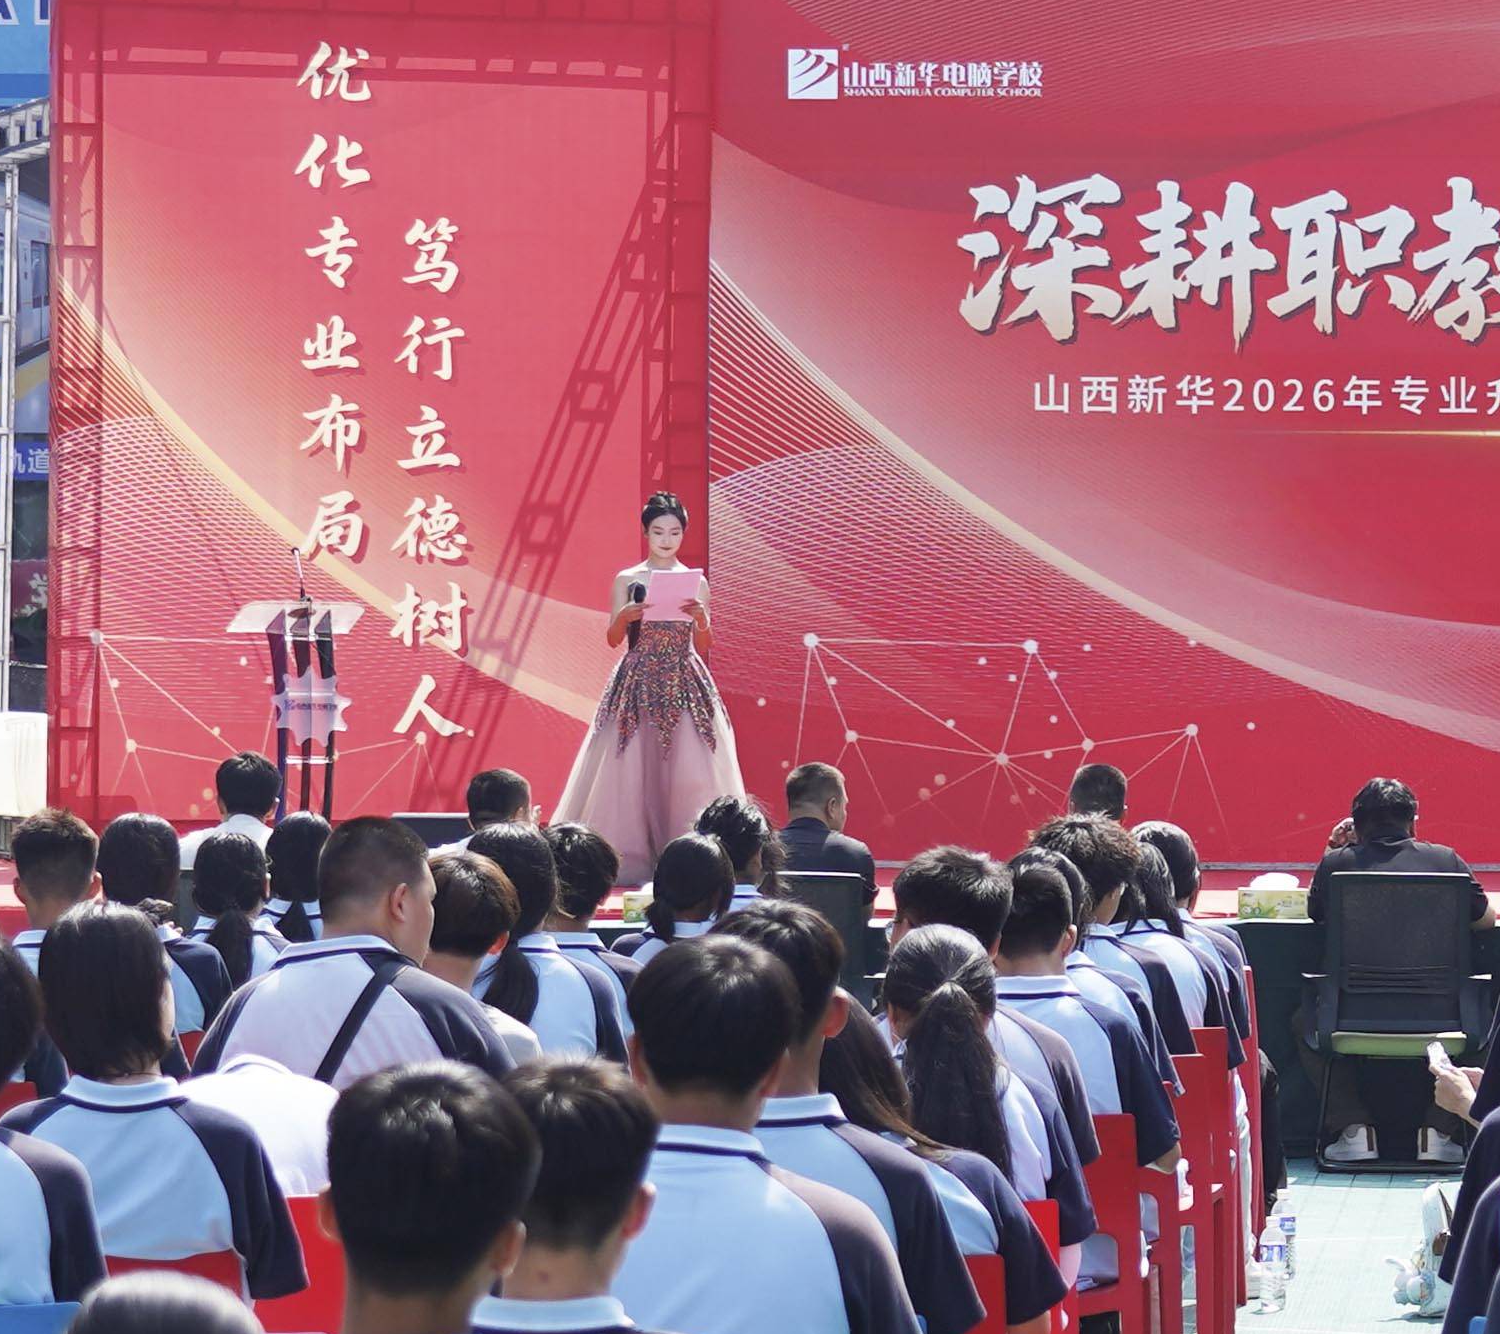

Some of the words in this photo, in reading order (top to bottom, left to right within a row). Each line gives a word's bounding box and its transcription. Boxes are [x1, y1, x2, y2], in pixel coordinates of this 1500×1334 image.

[843, 60, 1044, 87] 山西新华电脑学校
[843, 87, 886, 98] SHANXI
[887, 87, 932, 98] XINHUA
[934, 87, 995, 98] COMPUTER
[997, 87, 1043, 98] SCHOOL
[294, 41, 375, 563] 优化专业布局
[388, 216, 474, 744] 笃行立德树人
